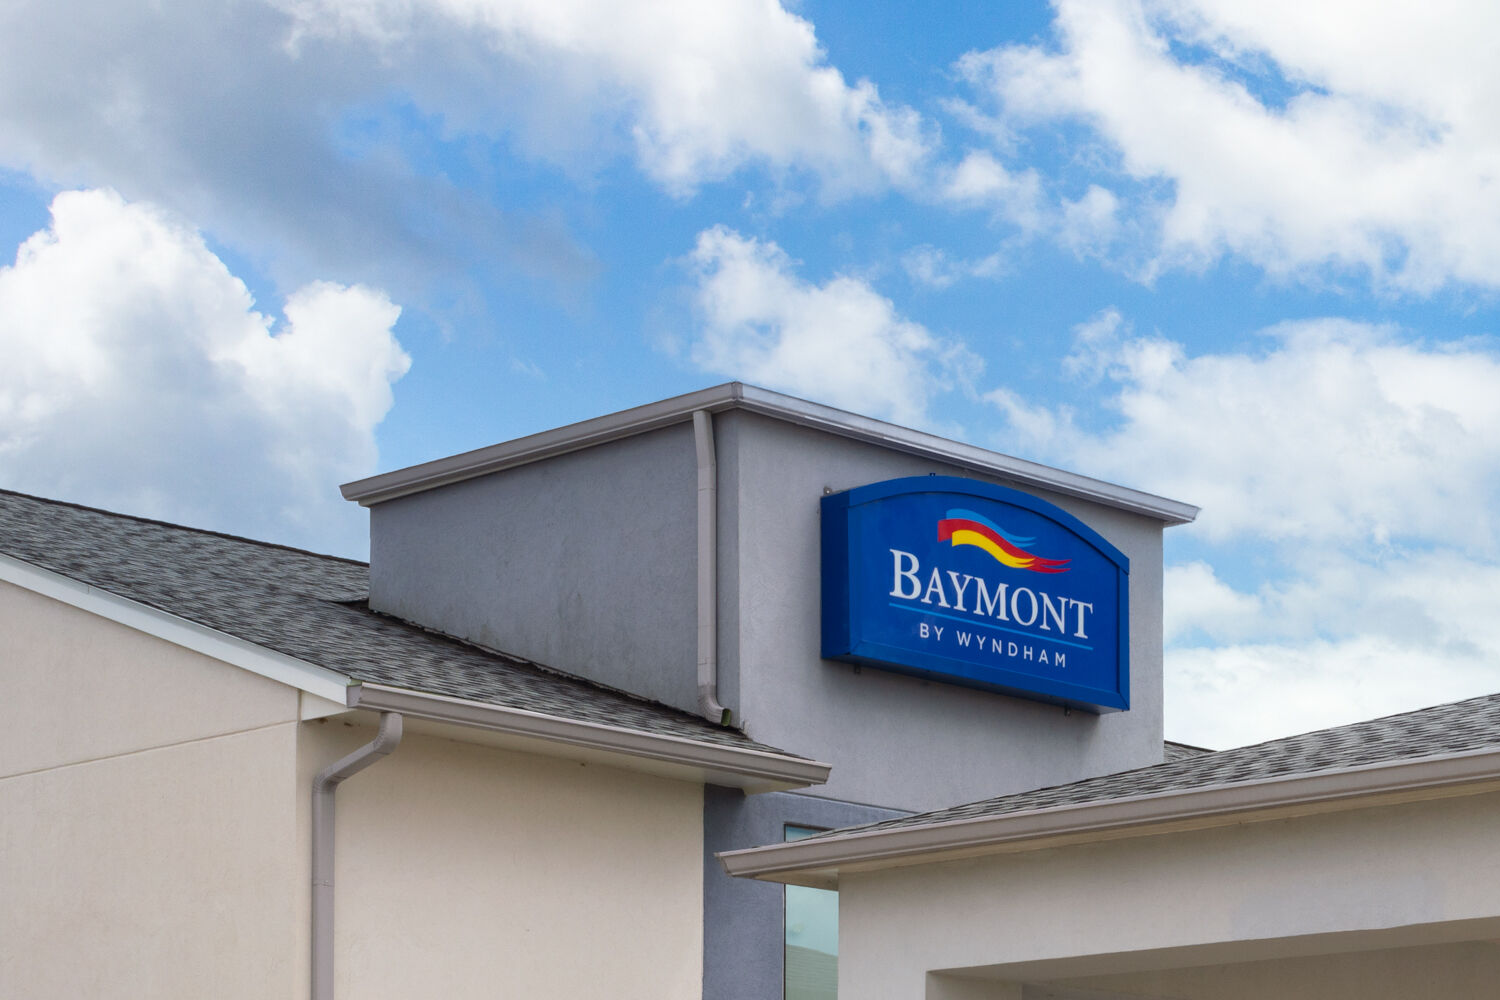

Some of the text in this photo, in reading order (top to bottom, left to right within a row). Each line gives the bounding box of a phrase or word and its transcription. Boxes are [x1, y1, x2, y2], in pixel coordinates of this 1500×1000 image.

[889, 549, 1093, 639] BAYMONT
[920, 623, 1066, 668] BY WYNDHAM
